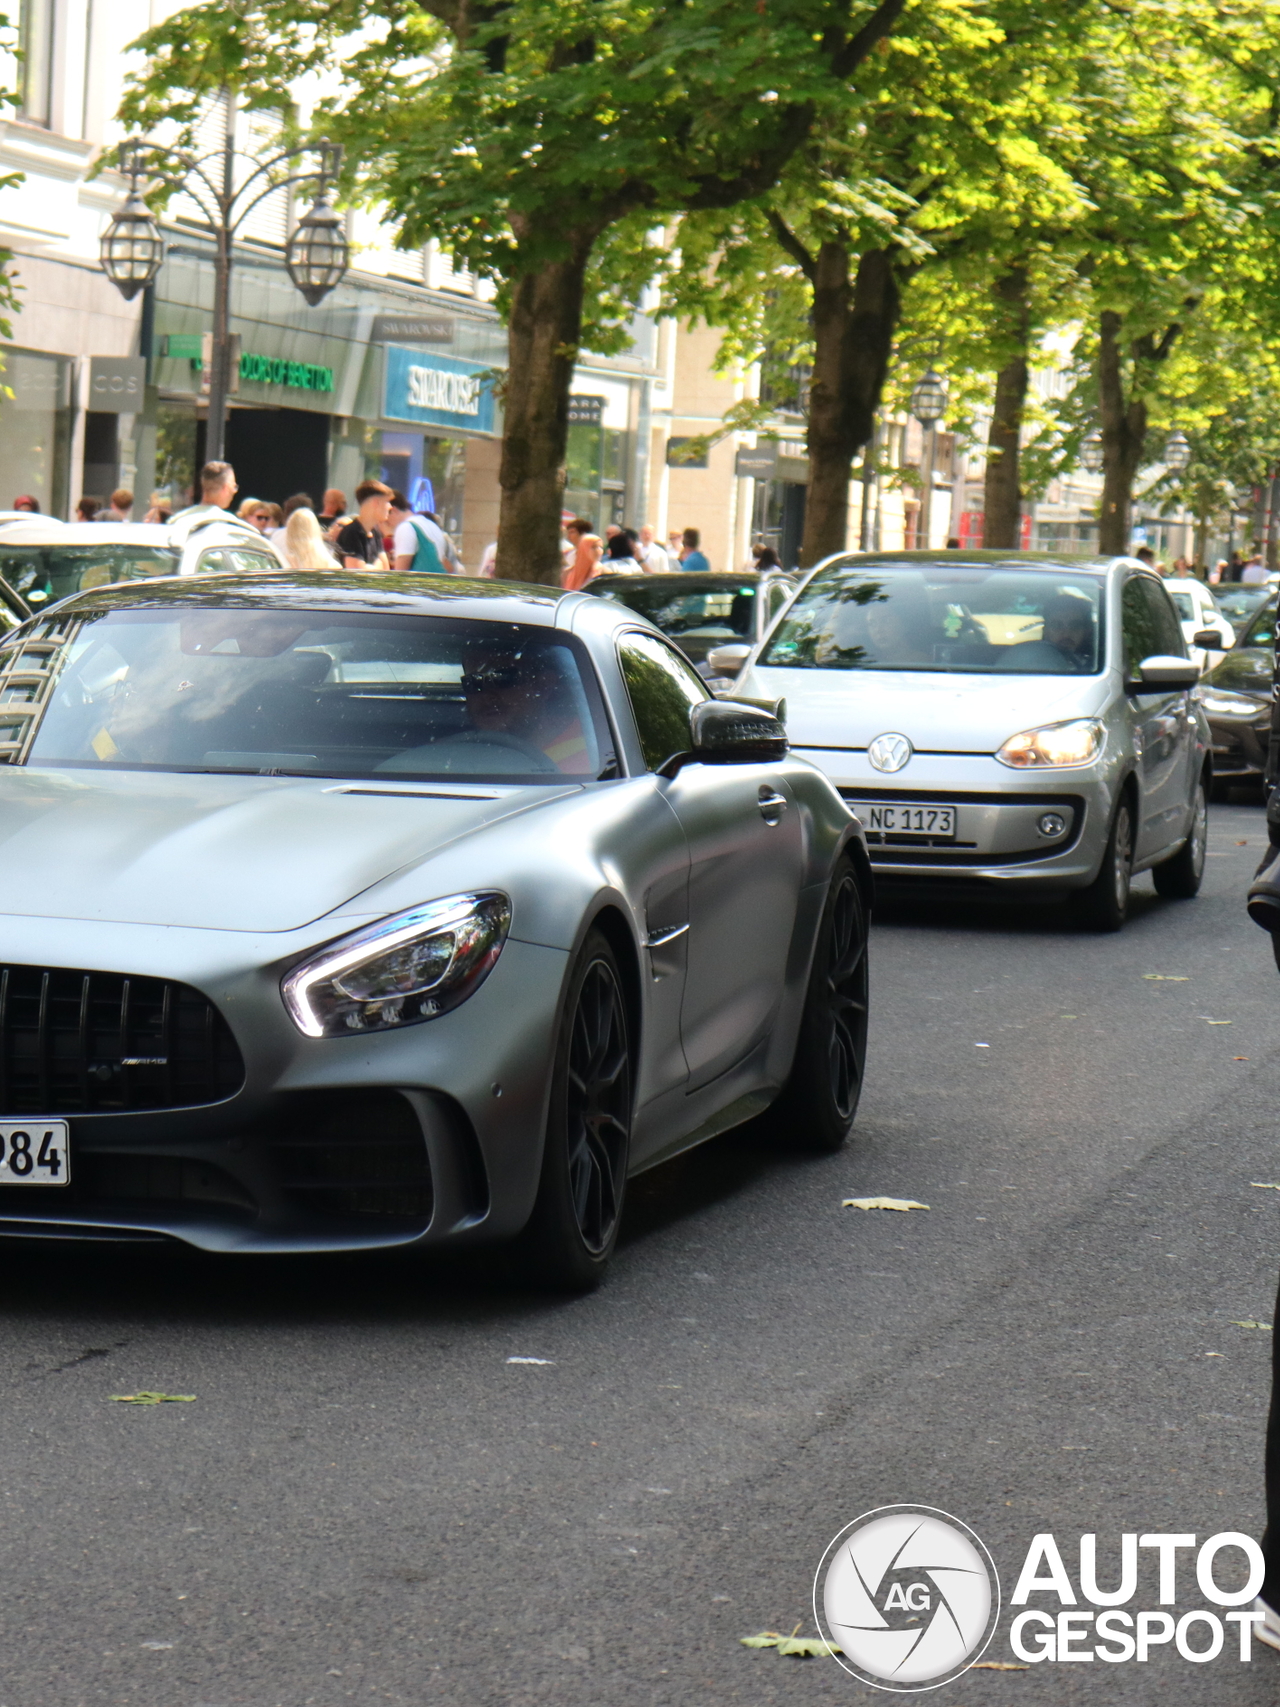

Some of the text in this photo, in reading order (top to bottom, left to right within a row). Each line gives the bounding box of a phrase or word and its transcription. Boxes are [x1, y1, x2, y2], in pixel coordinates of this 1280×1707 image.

[93, 374, 138, 393] COS
[570, 399, 600, 408] ARA
[569, 411, 600, 421] OME
[901, 809, 951, 832] 1173
